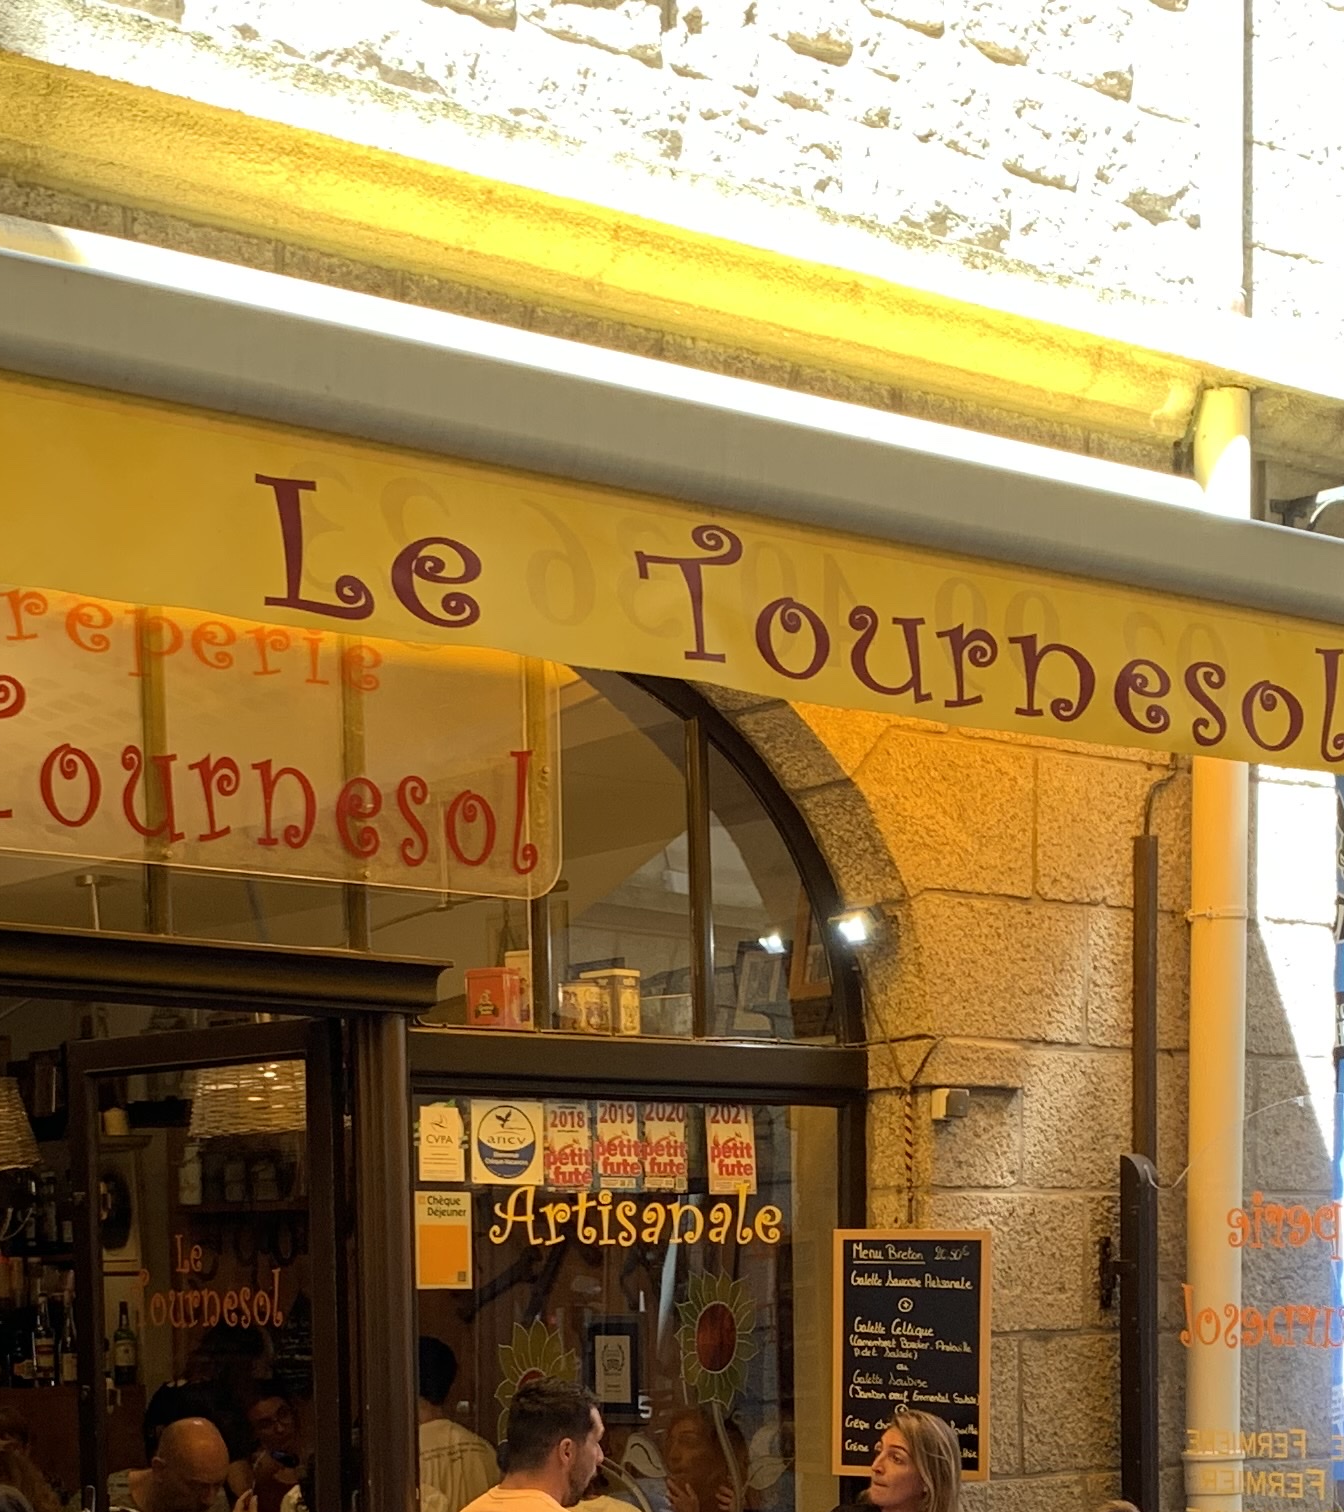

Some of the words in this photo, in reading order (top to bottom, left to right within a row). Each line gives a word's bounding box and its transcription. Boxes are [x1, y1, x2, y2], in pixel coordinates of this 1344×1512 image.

[255, 474, 481, 628] Le
[549, 1110, 586, 1129] 2018
[598, 1103, 636, 1124] 2019
[644, 1102, 685, 1123] 2020
[709, 1104, 750, 1125] 2021
[425, 1133, 454, 1145] CVPA
[486, 1135, 527, 1145] ancv
[594, 1138, 642, 1161] petit
[543, 1146, 593, 1170] petit
[639, 1138, 688, 1162] petit
[709, 1139, 753, 1163] petit
[427, 1194, 461, 1208] Chèque
[427, 1206, 467, 1219] Déjeuner
[488, 1183, 783, 1248] Artisanale
[174, 1234, 202, 1273] Le
[853, 1242, 885, 1261] Menu
[885, 1243, 925, 1261] Breton
[131, 1268, 284, 1330] Tournesol
[853, 1316, 886, 1335] Galette
[890, 1317, 935, 1338] Celtique
[852, 1369, 884, 1385] Galette
